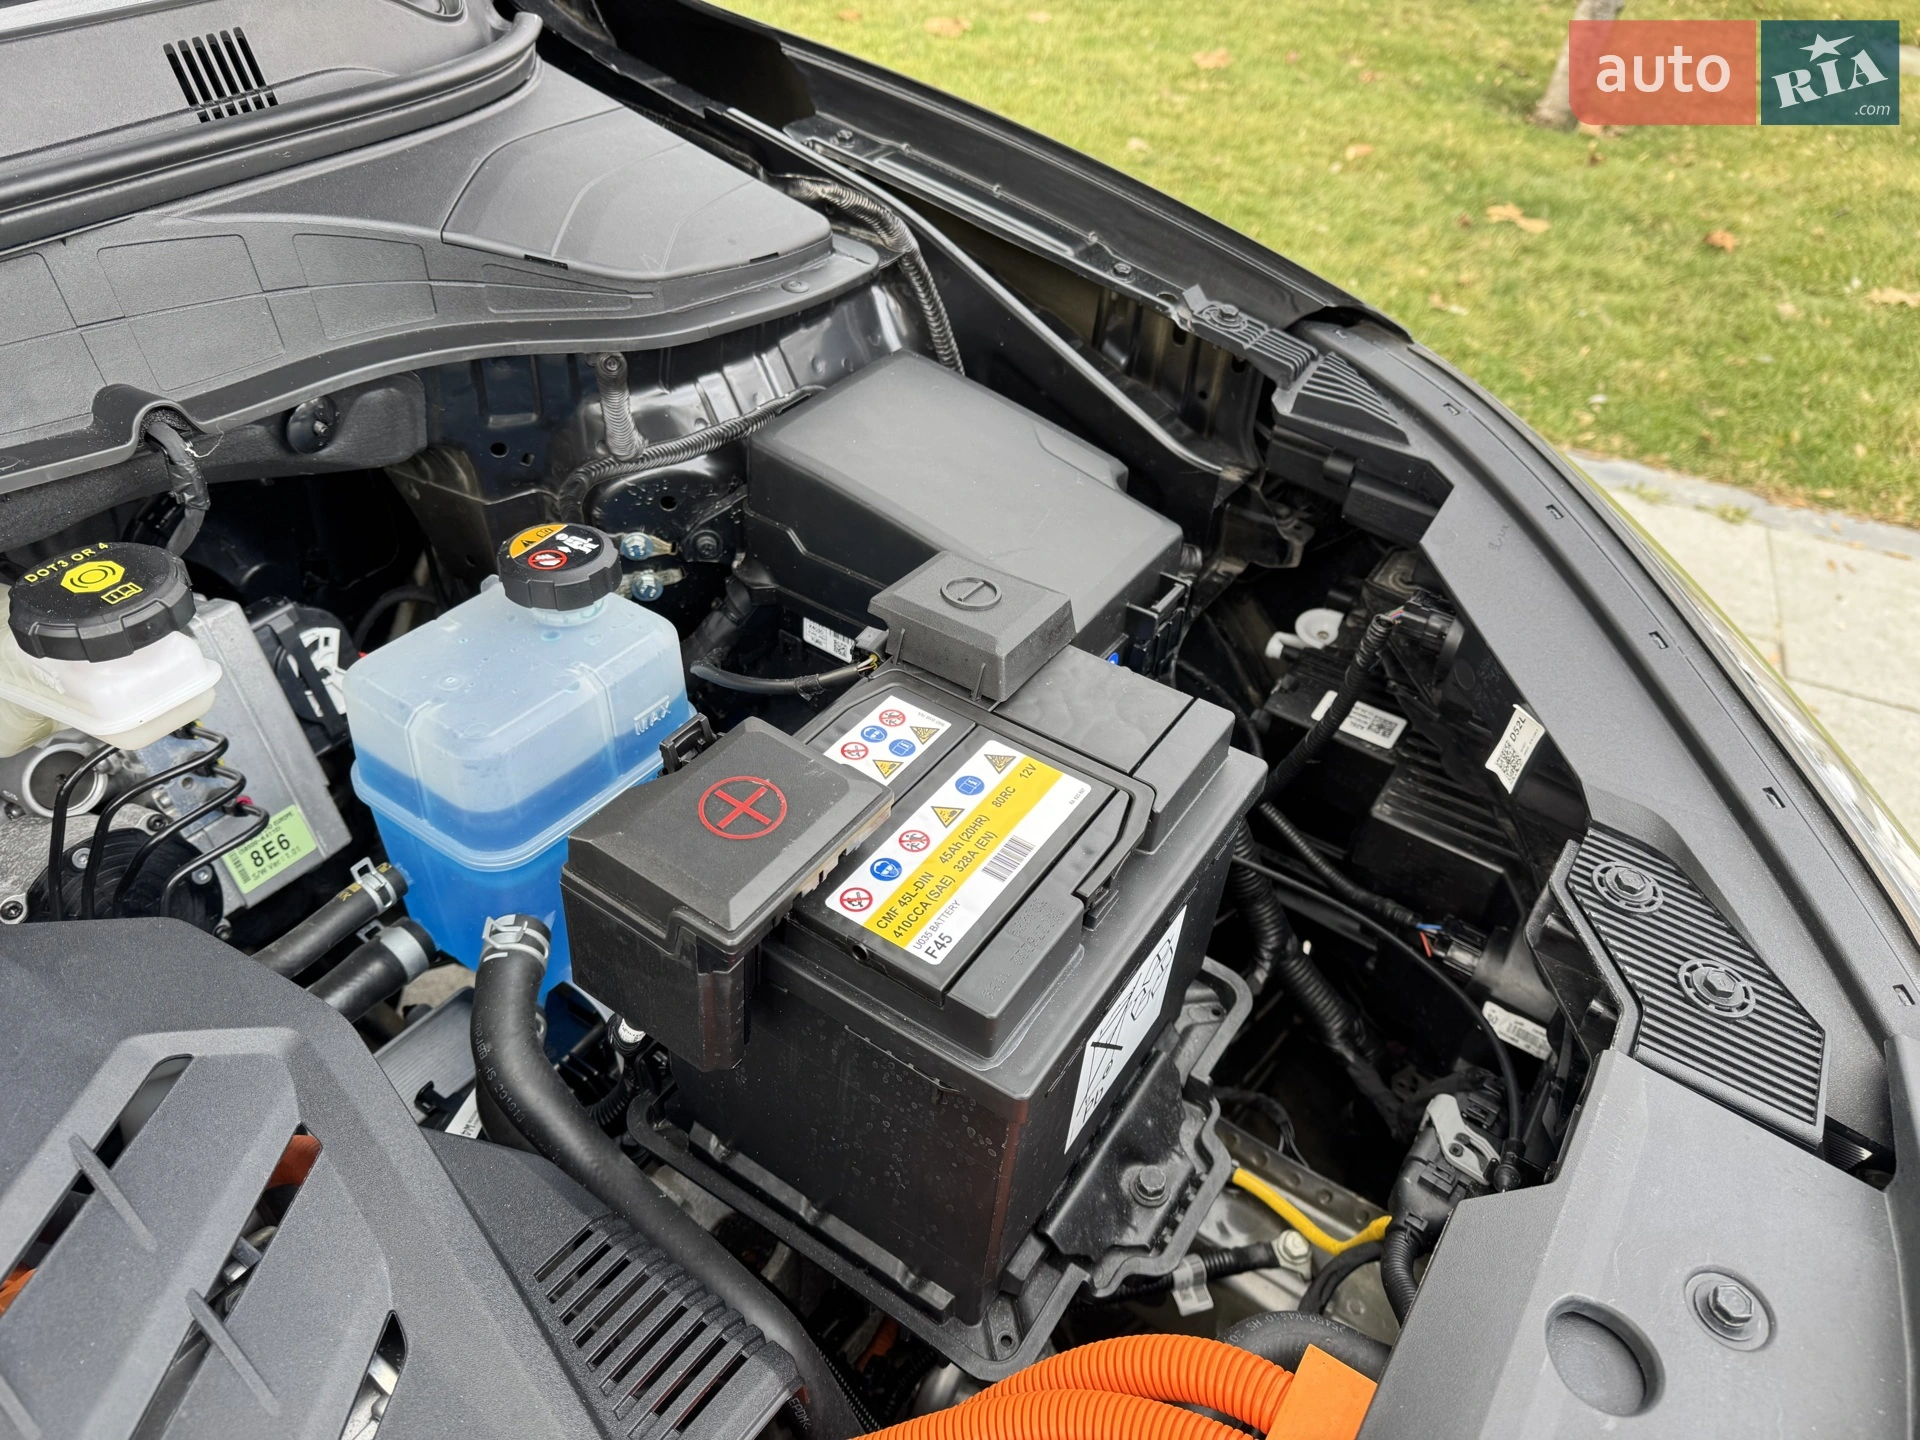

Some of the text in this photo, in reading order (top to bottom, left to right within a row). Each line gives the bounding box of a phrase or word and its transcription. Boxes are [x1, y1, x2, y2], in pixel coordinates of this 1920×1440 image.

[71, 547, 96, 561] OR
[98, 541, 109, 550] 4
[1509, 716, 1527, 742] D52L
[250, 833, 291, 868] 8E6
[876, 763, 1037, 929] CMF 45L-DIN 45Ah (20HR) 80RC 12V
[893, 830, 998, 939] 410CCA (SAE) 328A (EN)
[912, 899, 961, 950] U035 BATTERY
[924, 932, 953, 960] F45
[1245, 1319, 1264, 1332] HS
